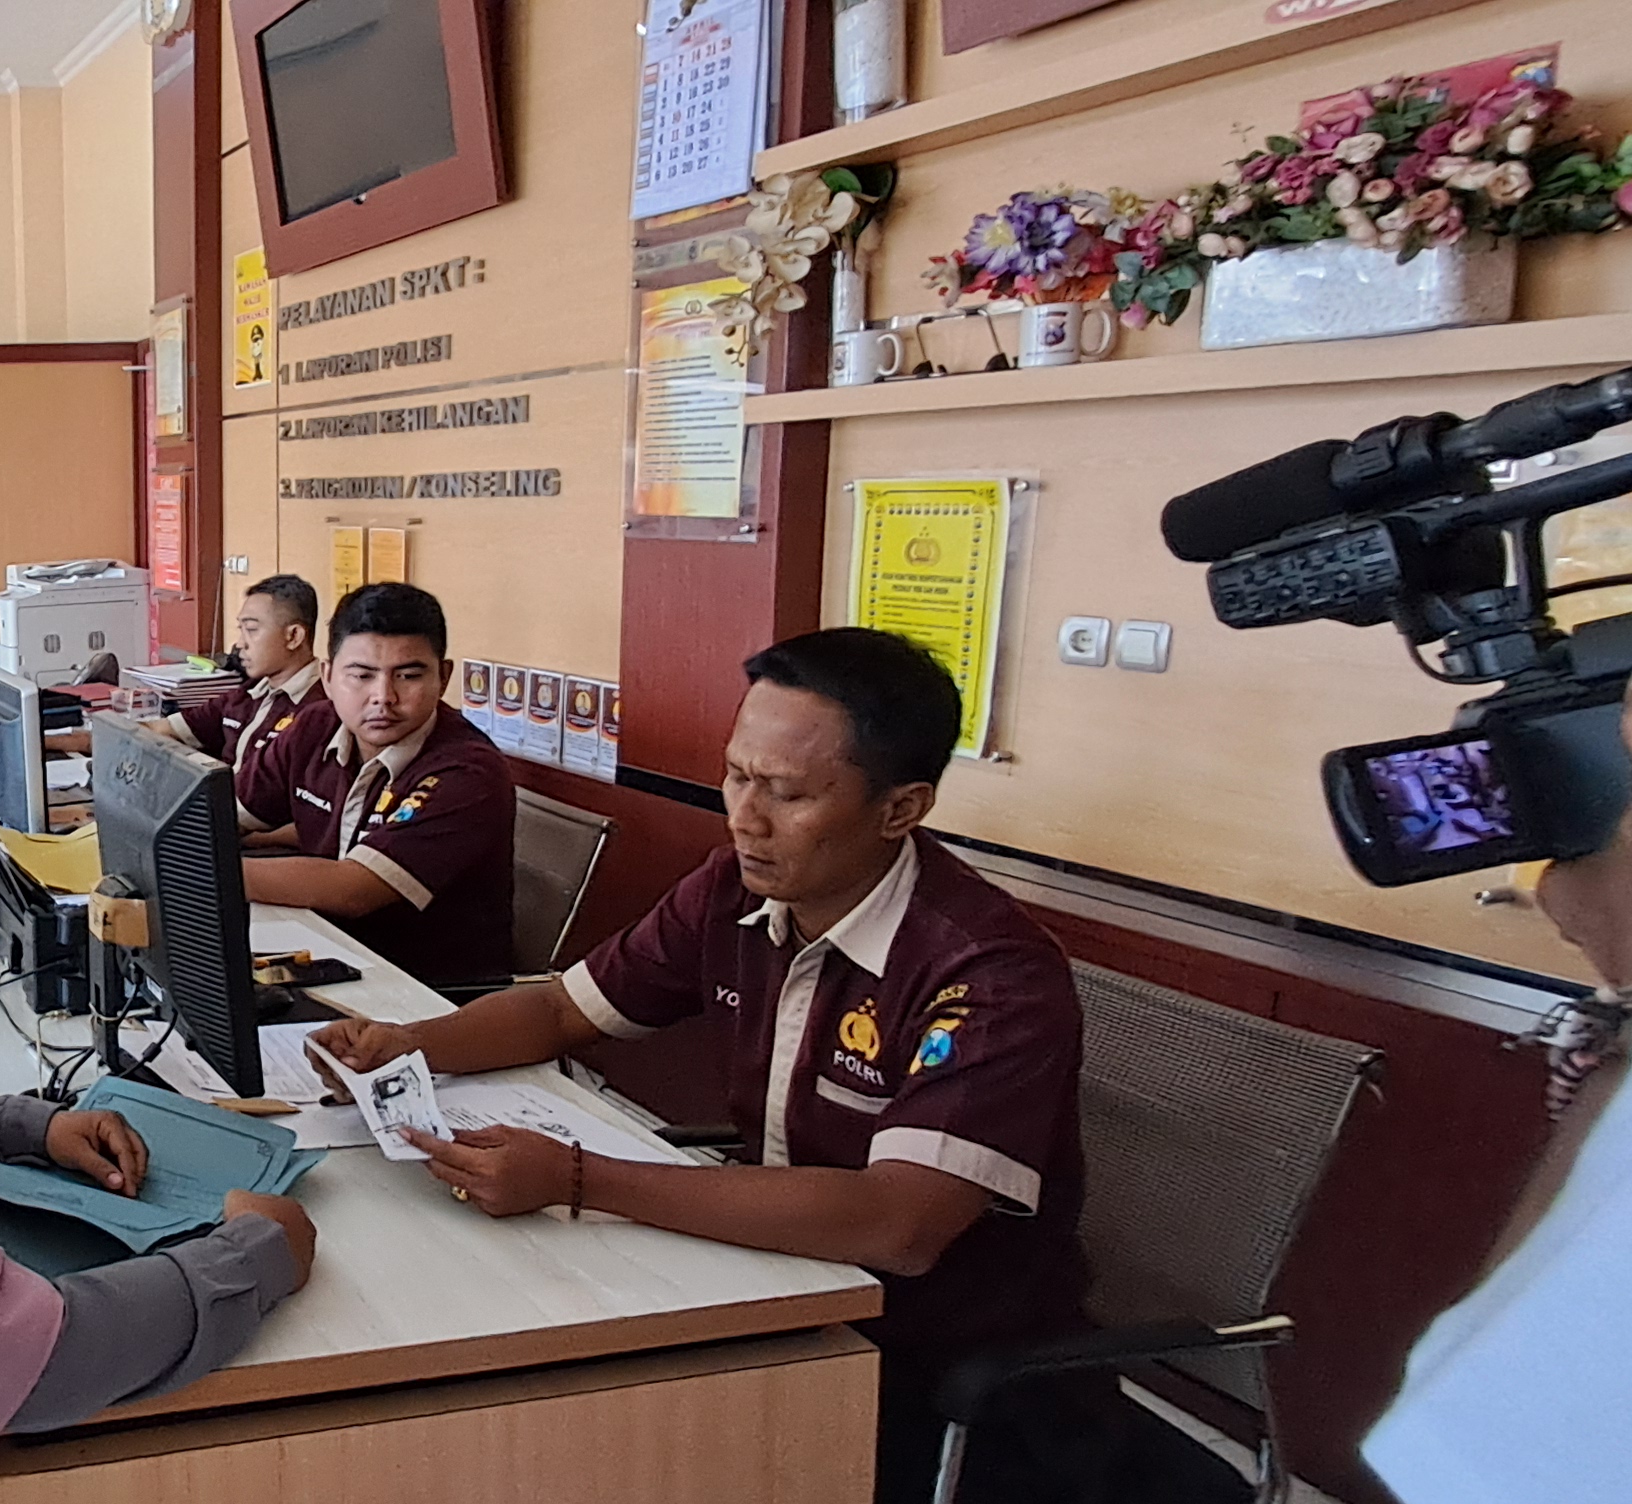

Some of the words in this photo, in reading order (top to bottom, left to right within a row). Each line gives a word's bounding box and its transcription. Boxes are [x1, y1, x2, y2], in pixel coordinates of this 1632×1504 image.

[278, 277, 395, 331] PELAYANAN
[295, 348, 379, 383] LAPORAN
[381, 334, 452, 370] POLISI
[379, 395, 530, 434] KEHILANGAN
[832, 1049, 886, 1087] POLRI
